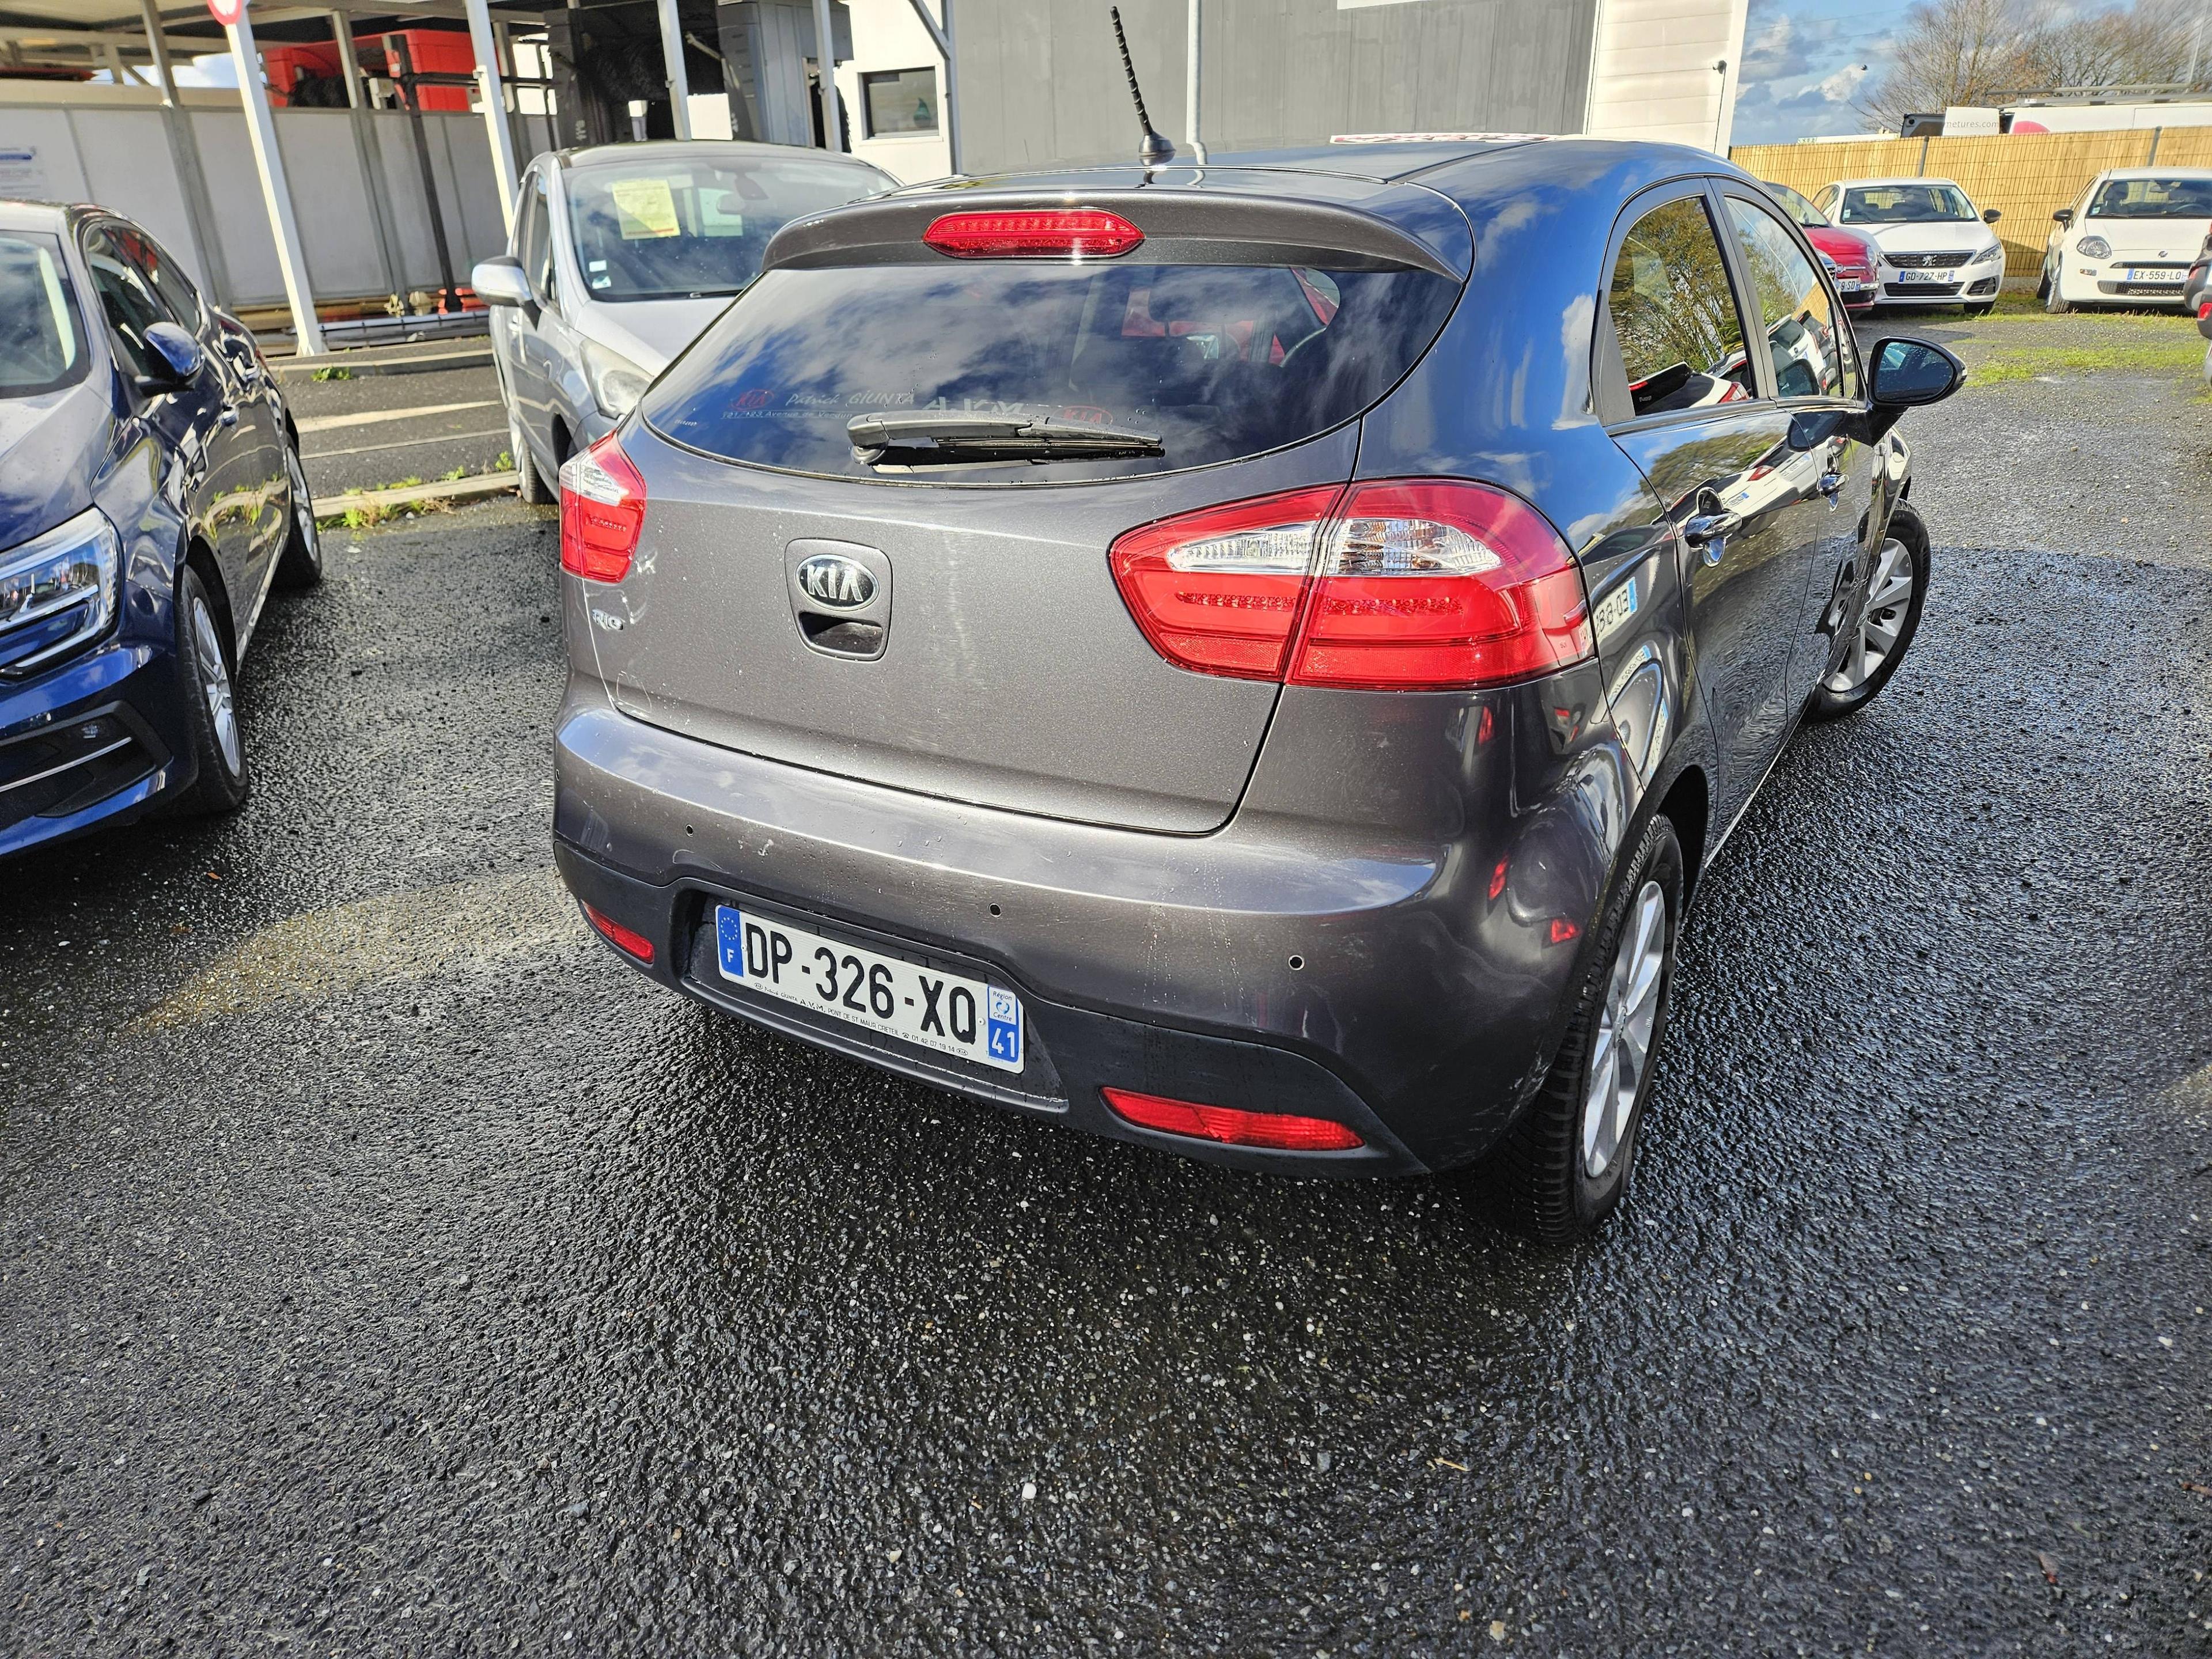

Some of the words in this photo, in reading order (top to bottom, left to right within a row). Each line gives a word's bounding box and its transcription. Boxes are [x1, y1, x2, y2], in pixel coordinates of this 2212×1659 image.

[1906, 272, 1948, 281] GD-727-HP
[806, 563, 864, 603] KIA
[727, 948, 734, 963] F
[745, 922, 977, 1045] DP-326-XQ
[992, 990, 1012, 1001] Région
[828, 1008, 842, 1018] PONT
[851, 1015, 858, 1023] ST
[860, 1018, 877, 1029] MAUR
[877, 1024, 899, 1036] CRETEIL
[993, 1012, 1012, 1022] Centre
[991, 1027, 1016, 1058] 41
